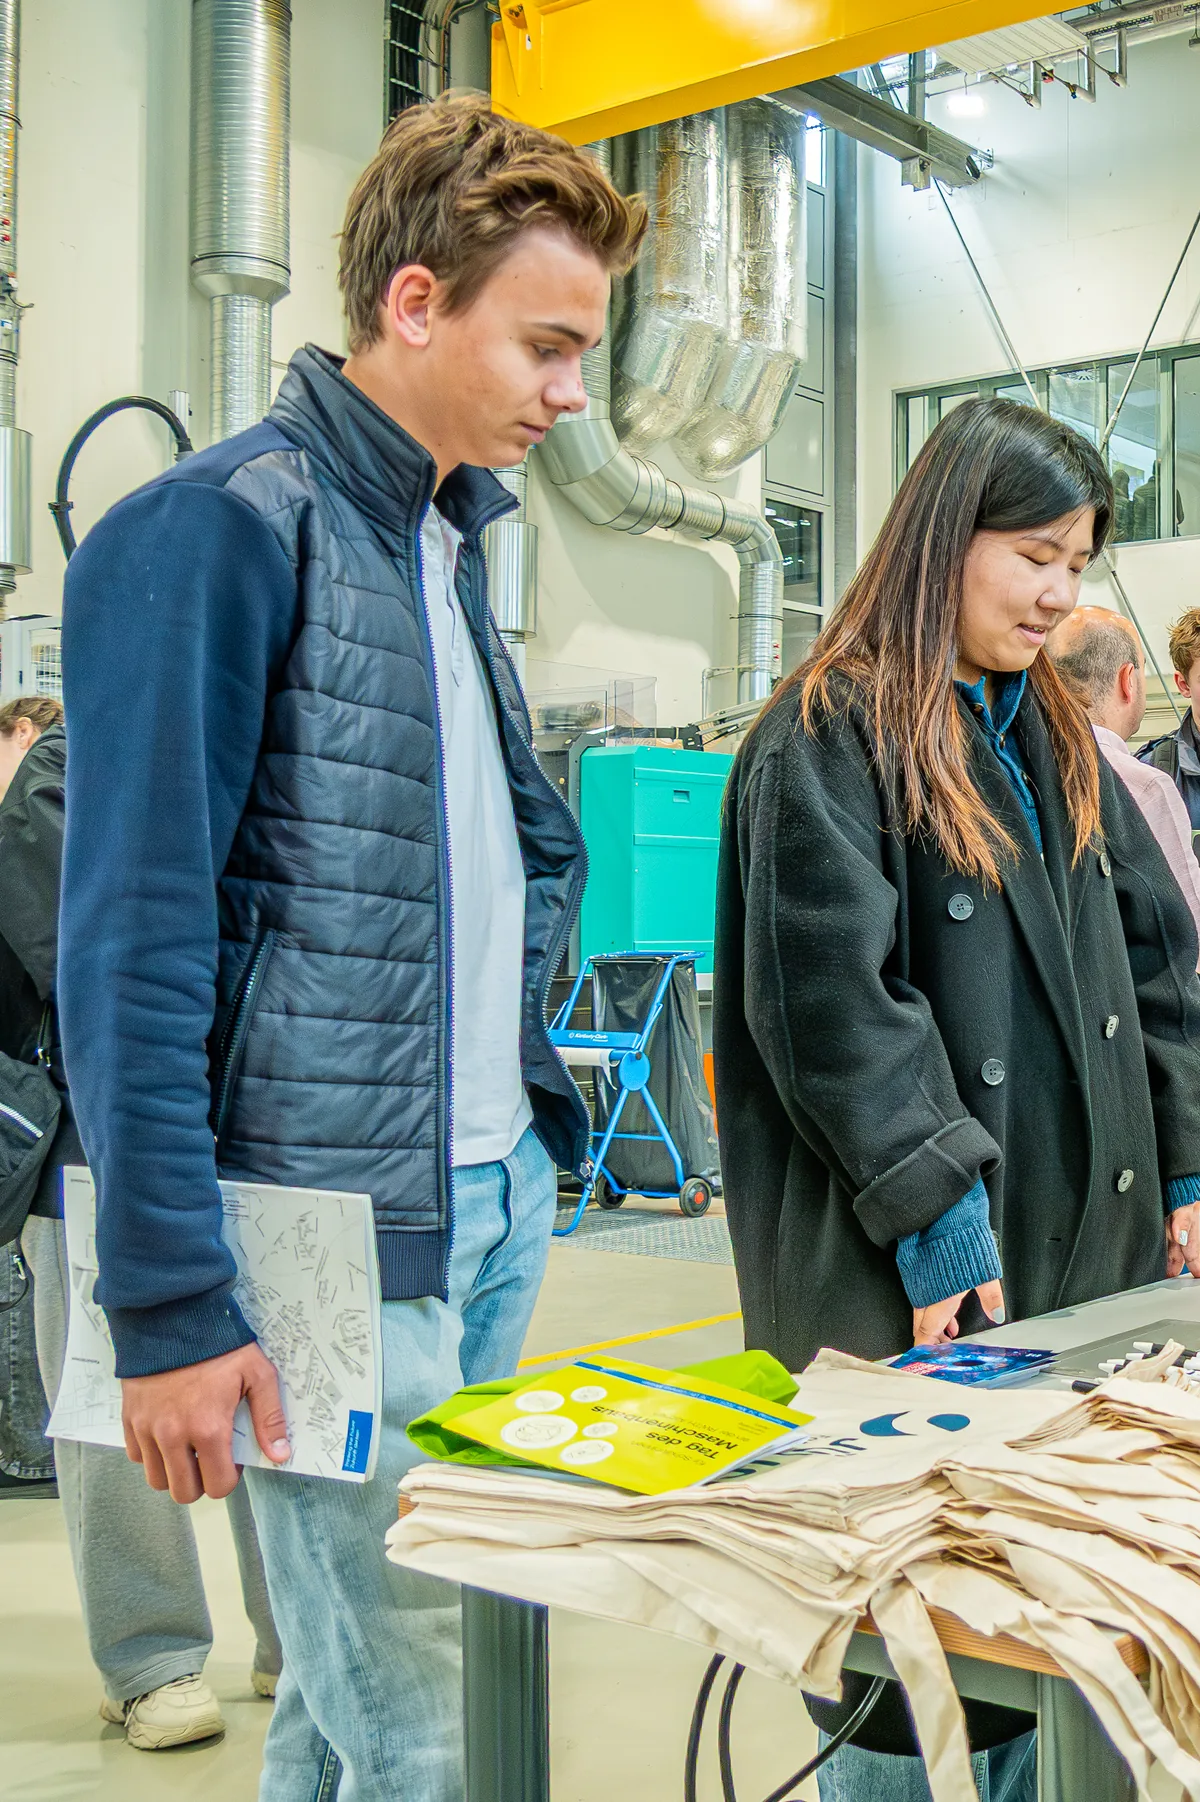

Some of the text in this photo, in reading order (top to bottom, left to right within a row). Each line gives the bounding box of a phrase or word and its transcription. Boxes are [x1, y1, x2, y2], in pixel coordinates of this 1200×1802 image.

[591, 1405, 738, 1450] Maschinenbaus
[646, 1431, 681, 1447] des
[686, 1442, 719, 1460] Tag
